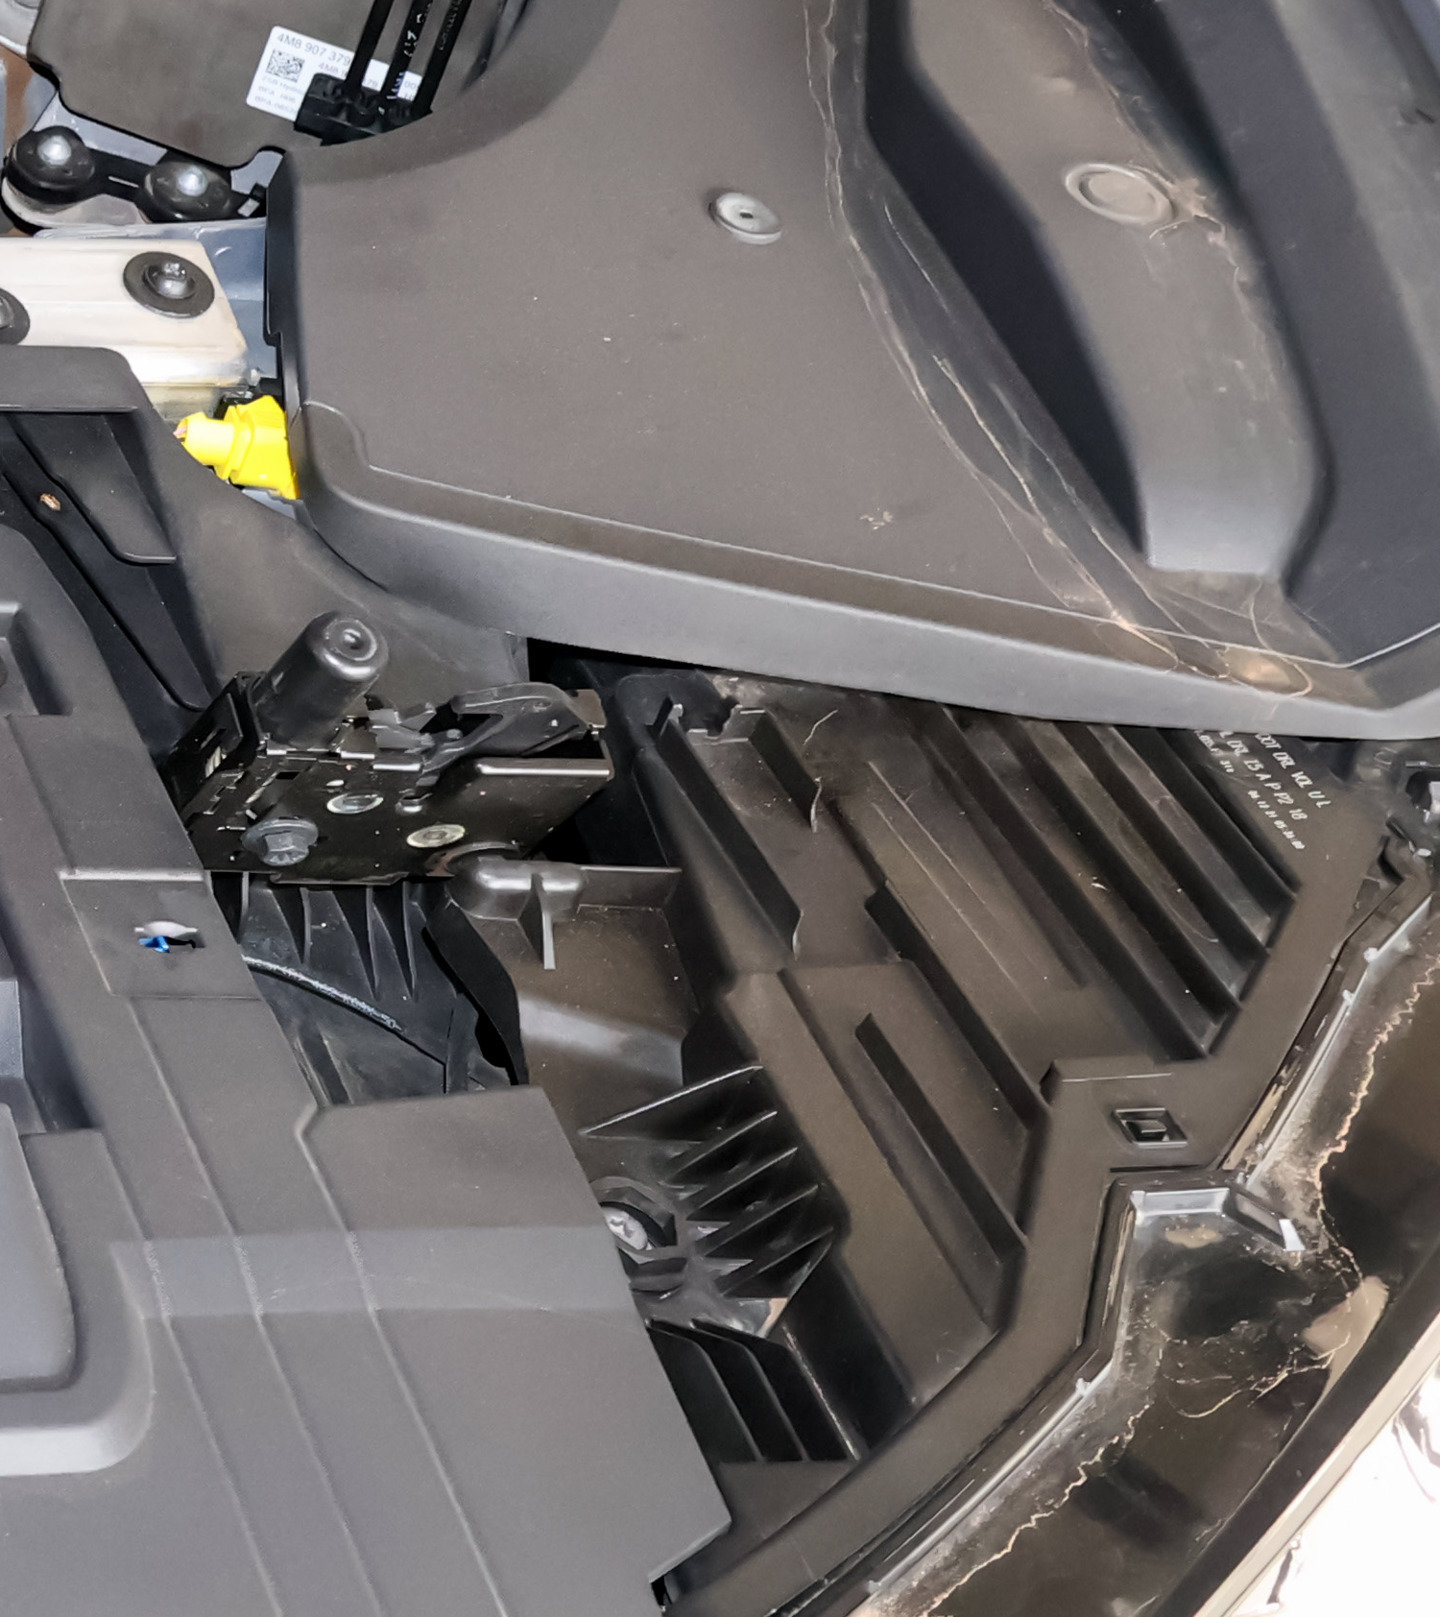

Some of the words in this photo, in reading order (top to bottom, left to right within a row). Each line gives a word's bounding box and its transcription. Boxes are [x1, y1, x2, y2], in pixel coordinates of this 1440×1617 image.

[304, 42, 327, 57] 907
[1255, 773, 1272, 781] A
[1264, 782, 1282, 790] P
